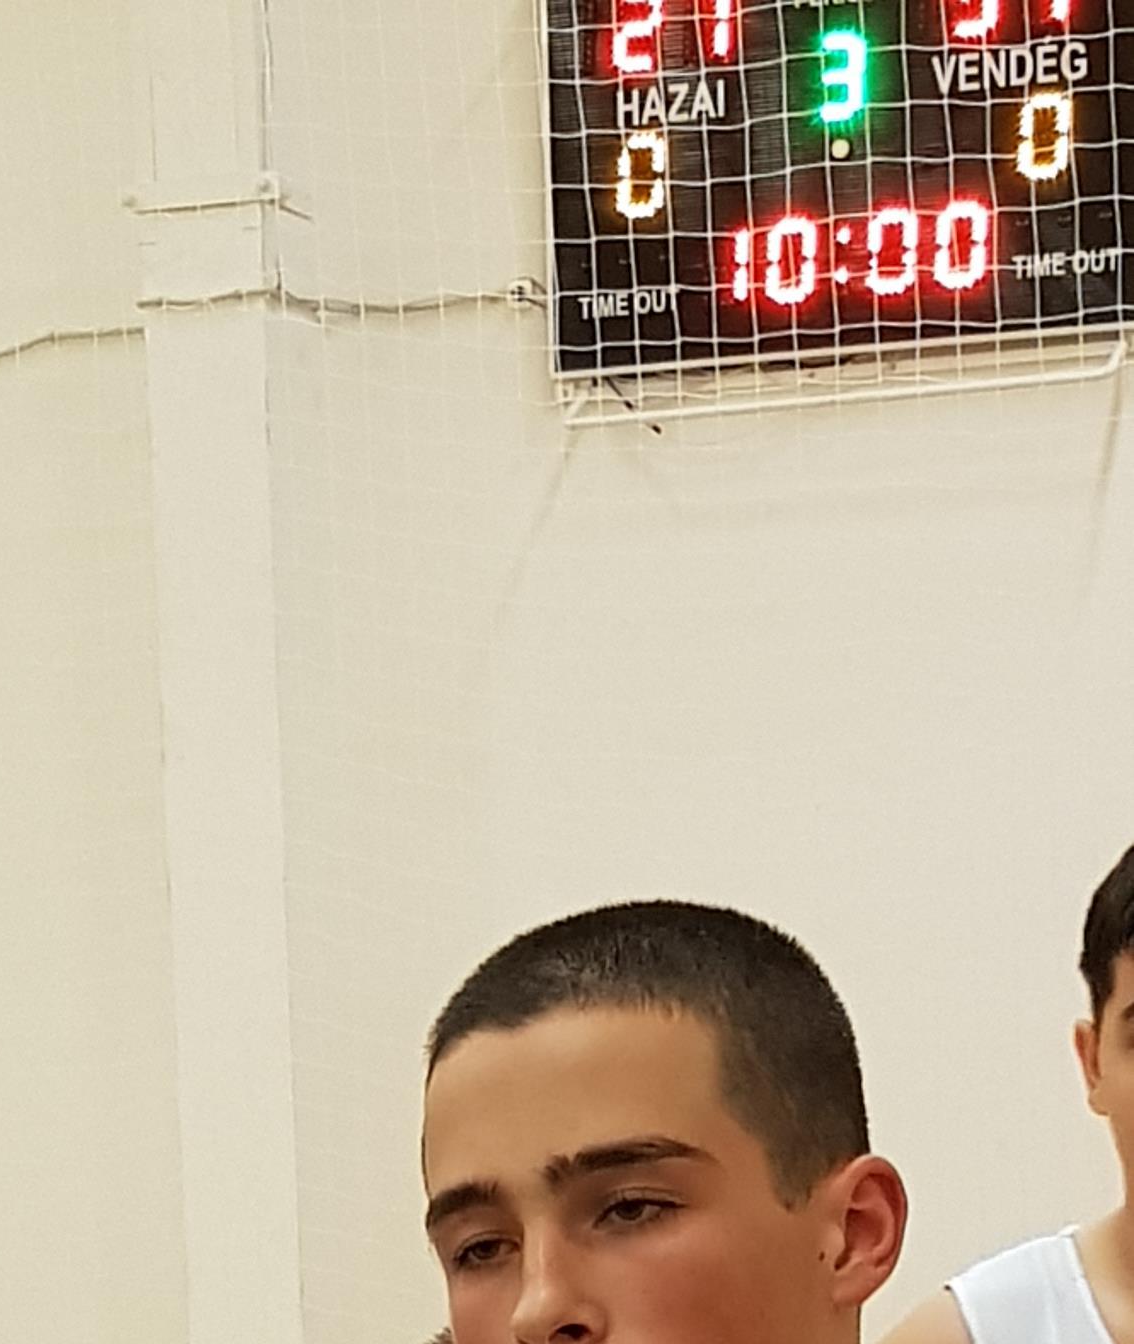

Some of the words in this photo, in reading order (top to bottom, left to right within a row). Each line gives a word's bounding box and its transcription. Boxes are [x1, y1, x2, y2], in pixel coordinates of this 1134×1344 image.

[821, 29, 867, 122] 3
[931, 36, 1088, 95] VENDÉG
[617, 79, 726, 127] HAZAI
[1016, 92, 1072, 181] 0
[616, 130, 666, 219] 0
[733, 200, 989, 304] 10:00
[1011, 251, 1066, 280] TIME
[1072, 247, 1122, 275] OUT
[577, 291, 630, 320] TIME
[634, 287, 679, 315] OUT
